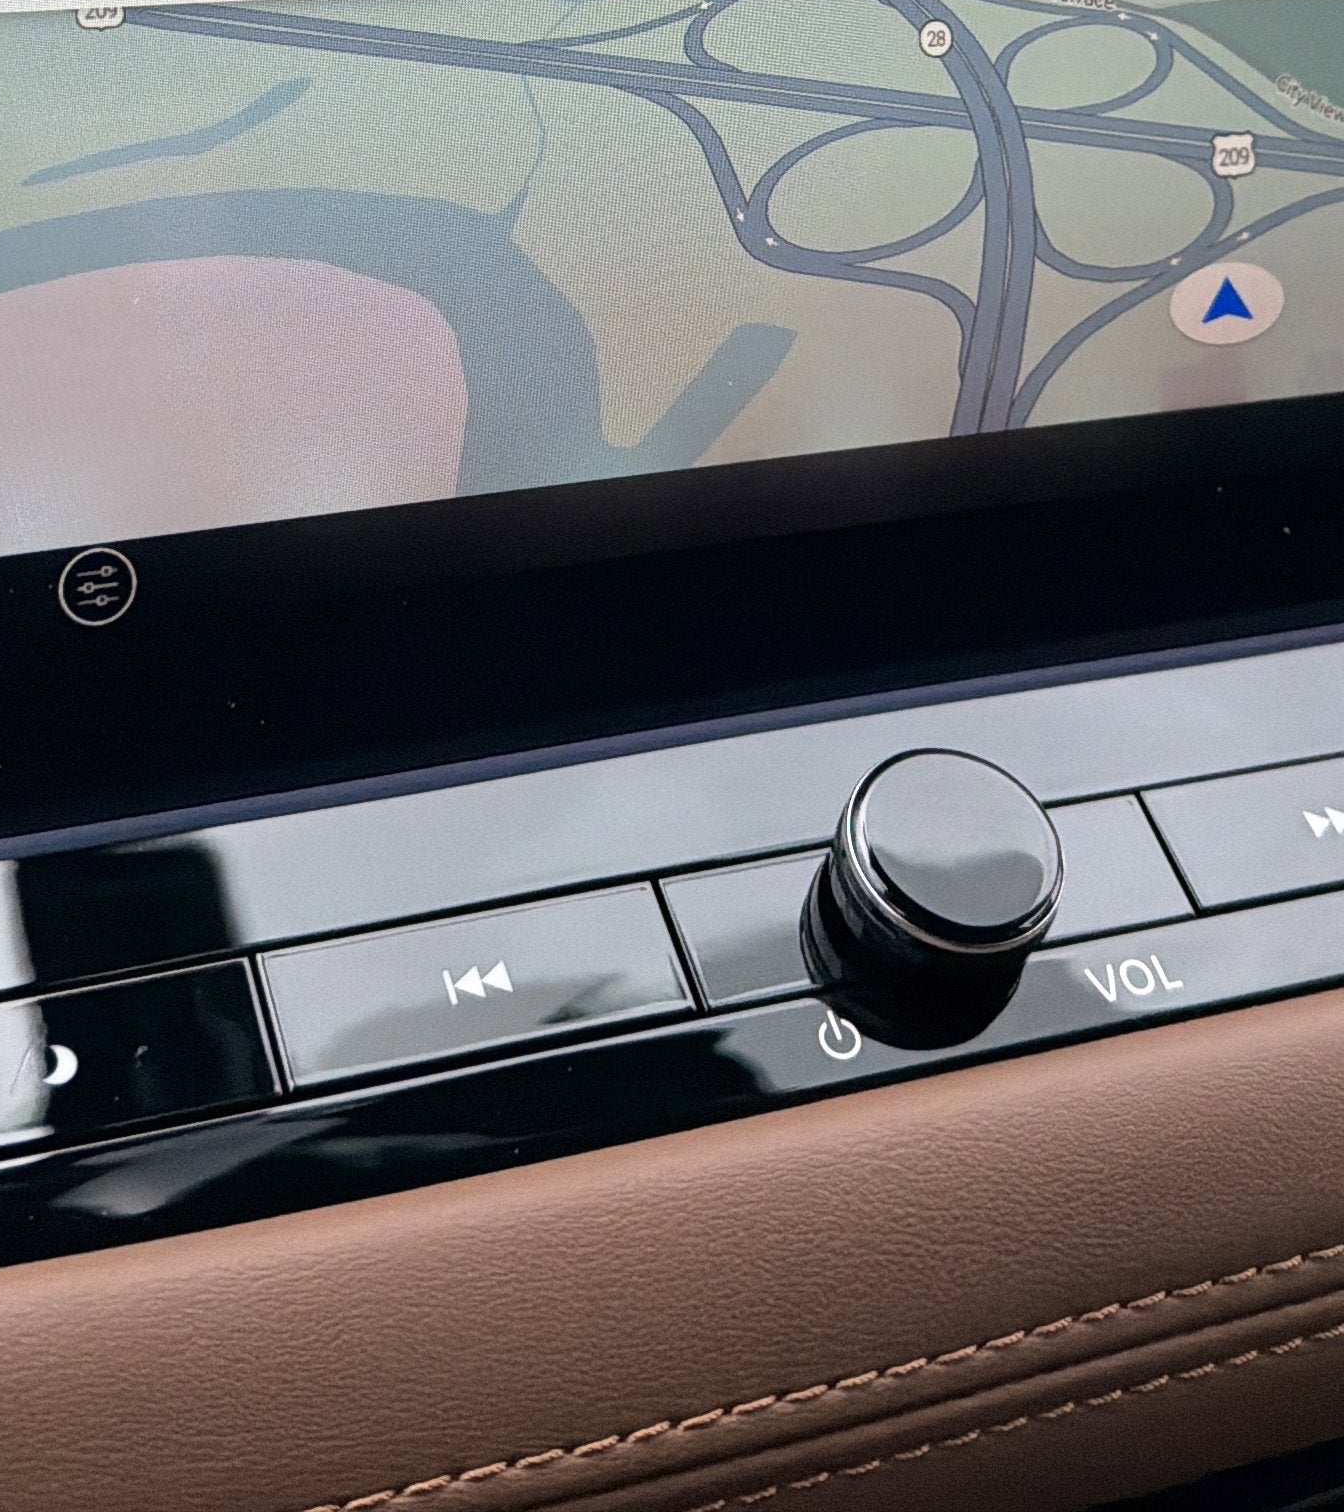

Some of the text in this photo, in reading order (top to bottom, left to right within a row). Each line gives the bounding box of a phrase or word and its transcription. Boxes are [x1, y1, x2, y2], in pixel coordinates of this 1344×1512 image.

[926, 29, 947, 48] 28
[1276, 74, 1305, 107] City
[1307, 92, 1344, 123] View
[1217, 146, 1250, 167] 209
[1083, 954, 1184, 1003] VOL
